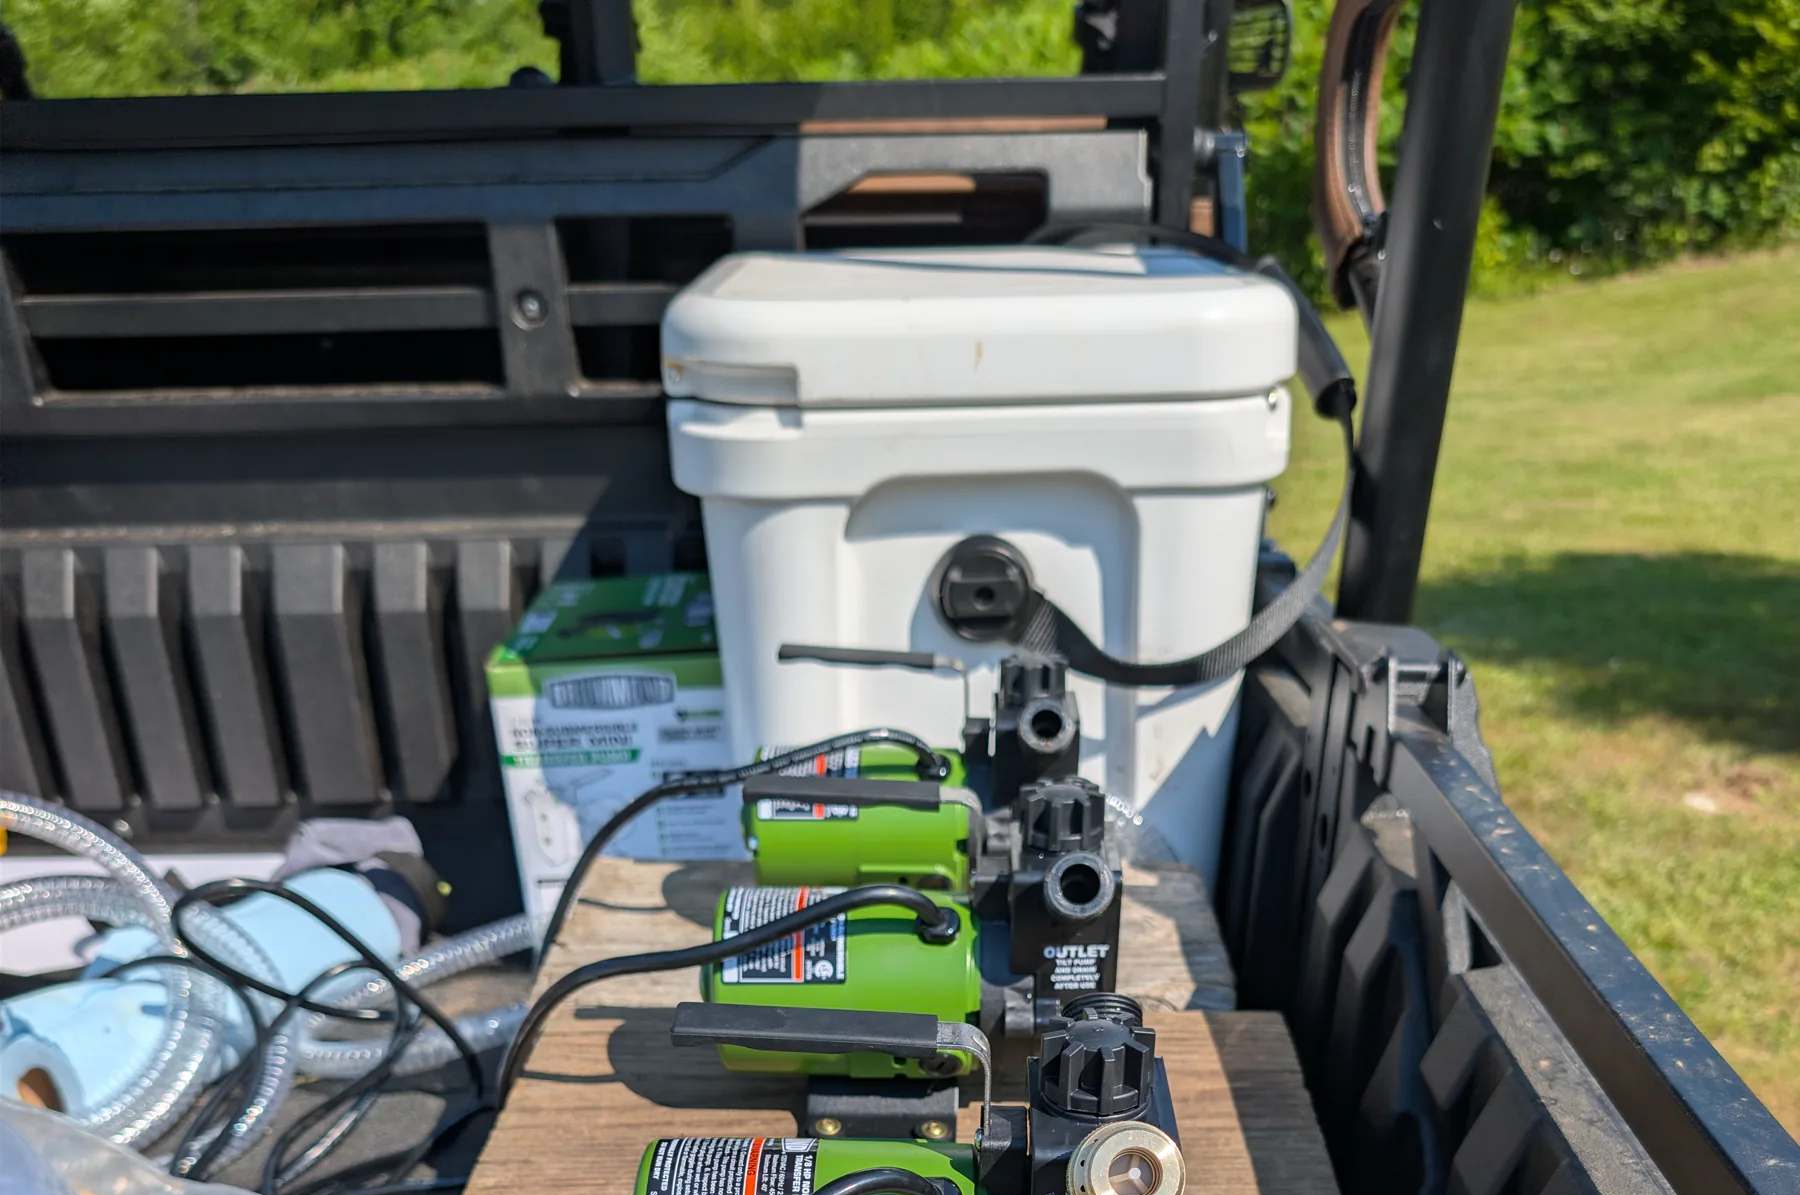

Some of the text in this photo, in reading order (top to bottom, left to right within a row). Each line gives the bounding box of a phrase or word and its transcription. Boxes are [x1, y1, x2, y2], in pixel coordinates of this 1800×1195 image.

[1044, 944, 1110, 958] OUTLET
[738, 1151, 746, 1166] Connect
[747, 1146, 760, 1176] WARNING
[763, 1154, 771, 1173] Maximum
[771, 1154, 780, 1173] Maximum
[804, 1154, 813, 1167] 1/8
[653, 1168, 661, 1180] DRY
[661, 1157, 672, 1191] PROTECTED
[685, 1169, 693, 1183] during
[792, 1154, 804, 1192] TRANSFER
[803, 1168, 812, 1179] HP
[702, 1173, 710, 1191] Inspect
